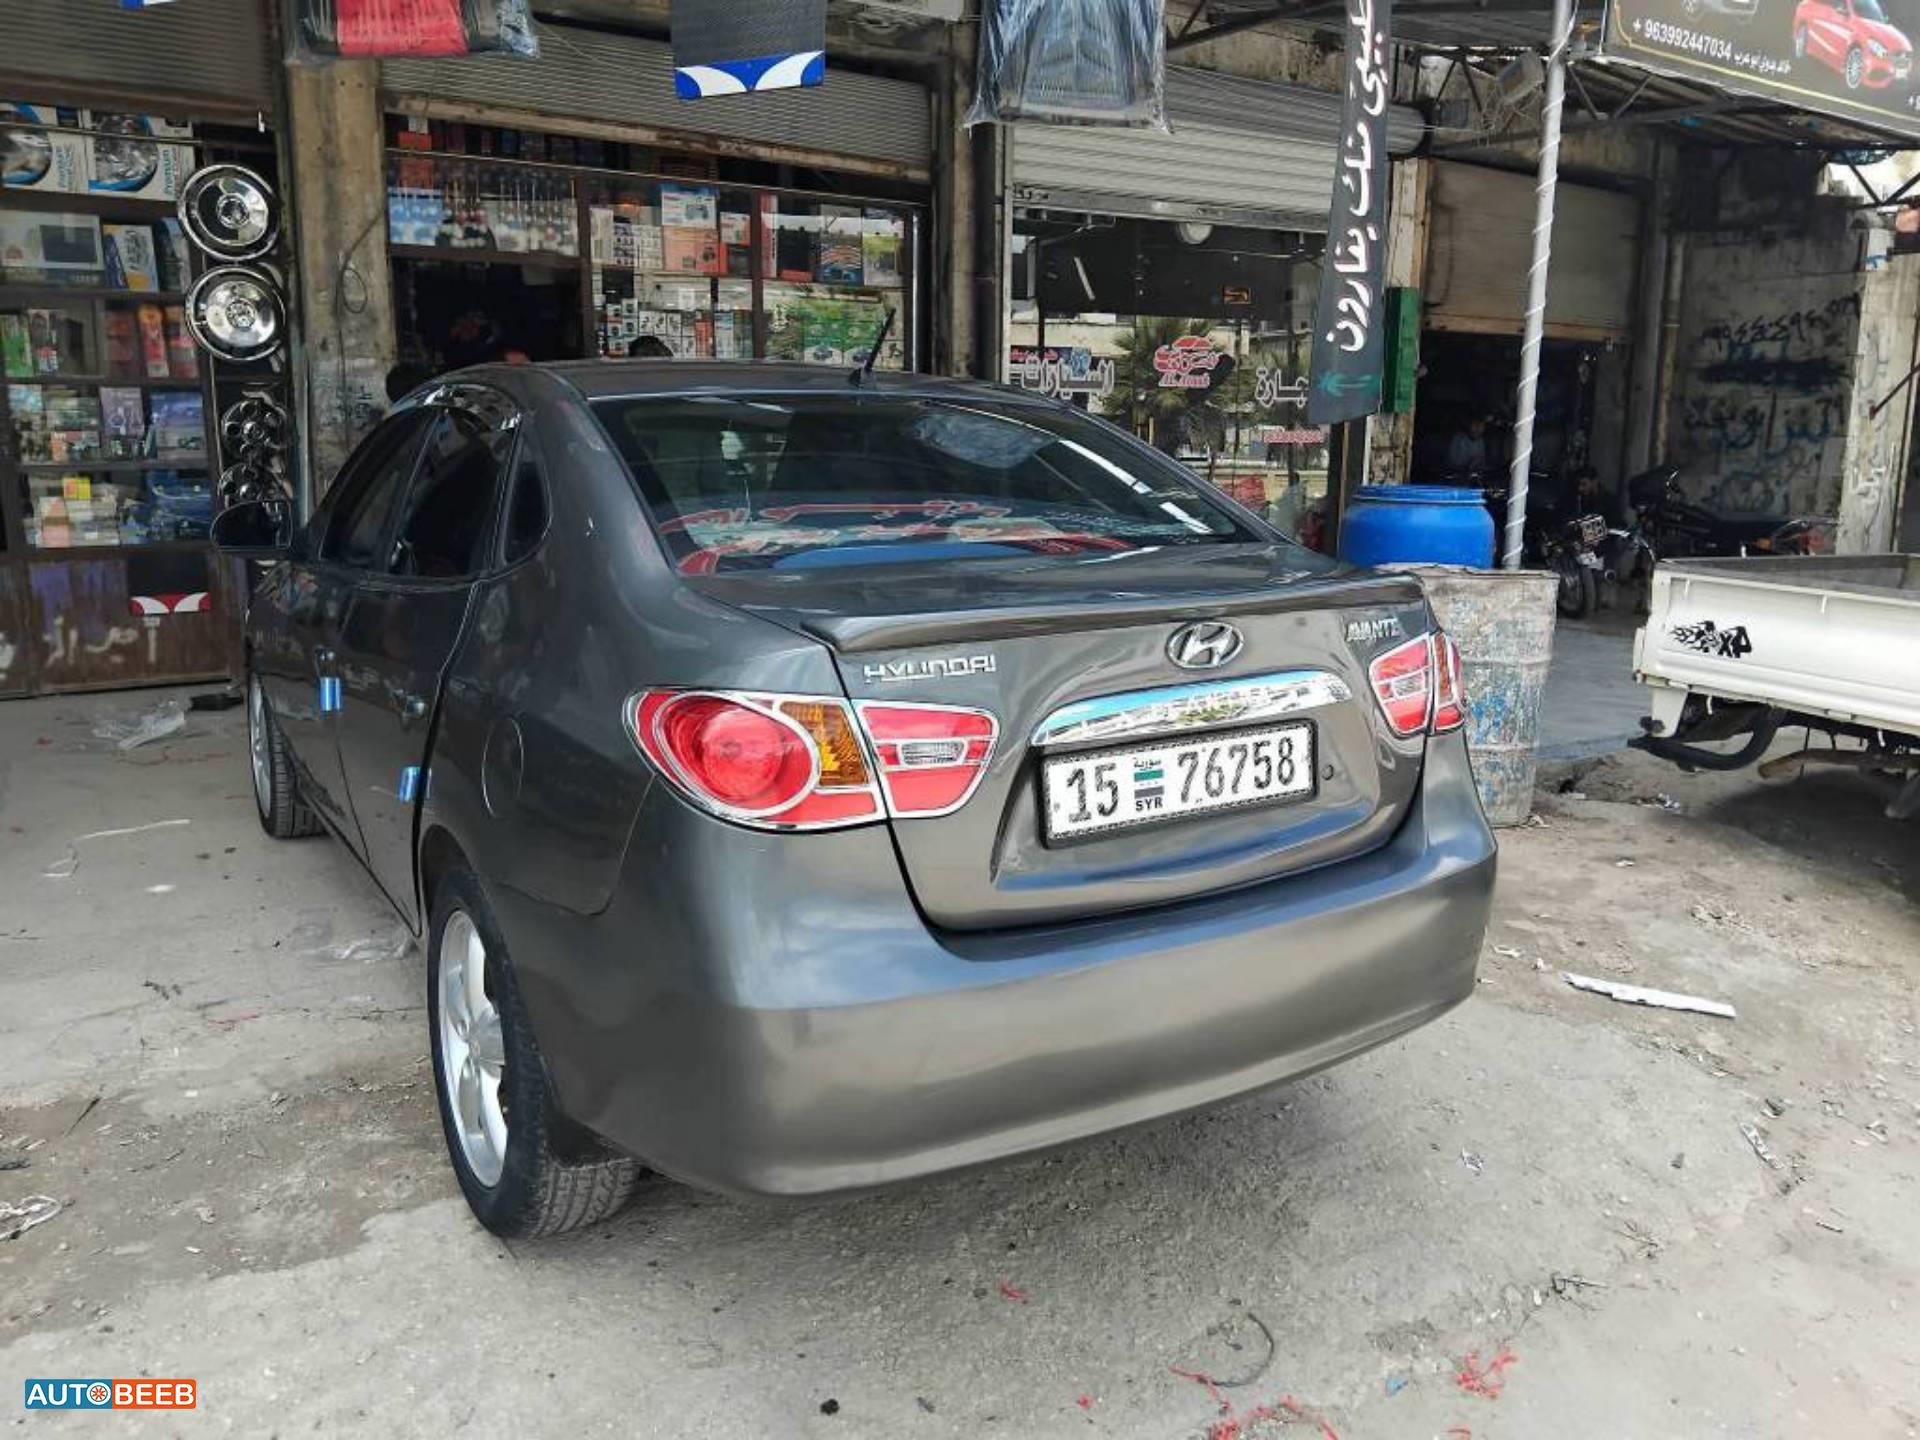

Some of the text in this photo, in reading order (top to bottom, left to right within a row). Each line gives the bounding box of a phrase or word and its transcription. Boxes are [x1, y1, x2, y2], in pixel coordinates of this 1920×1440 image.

[863, 653, 997, 684] HYUNDAI
[1066, 737, 1296, 824] 15 76758
[1135, 796, 1164, 812] SYR
